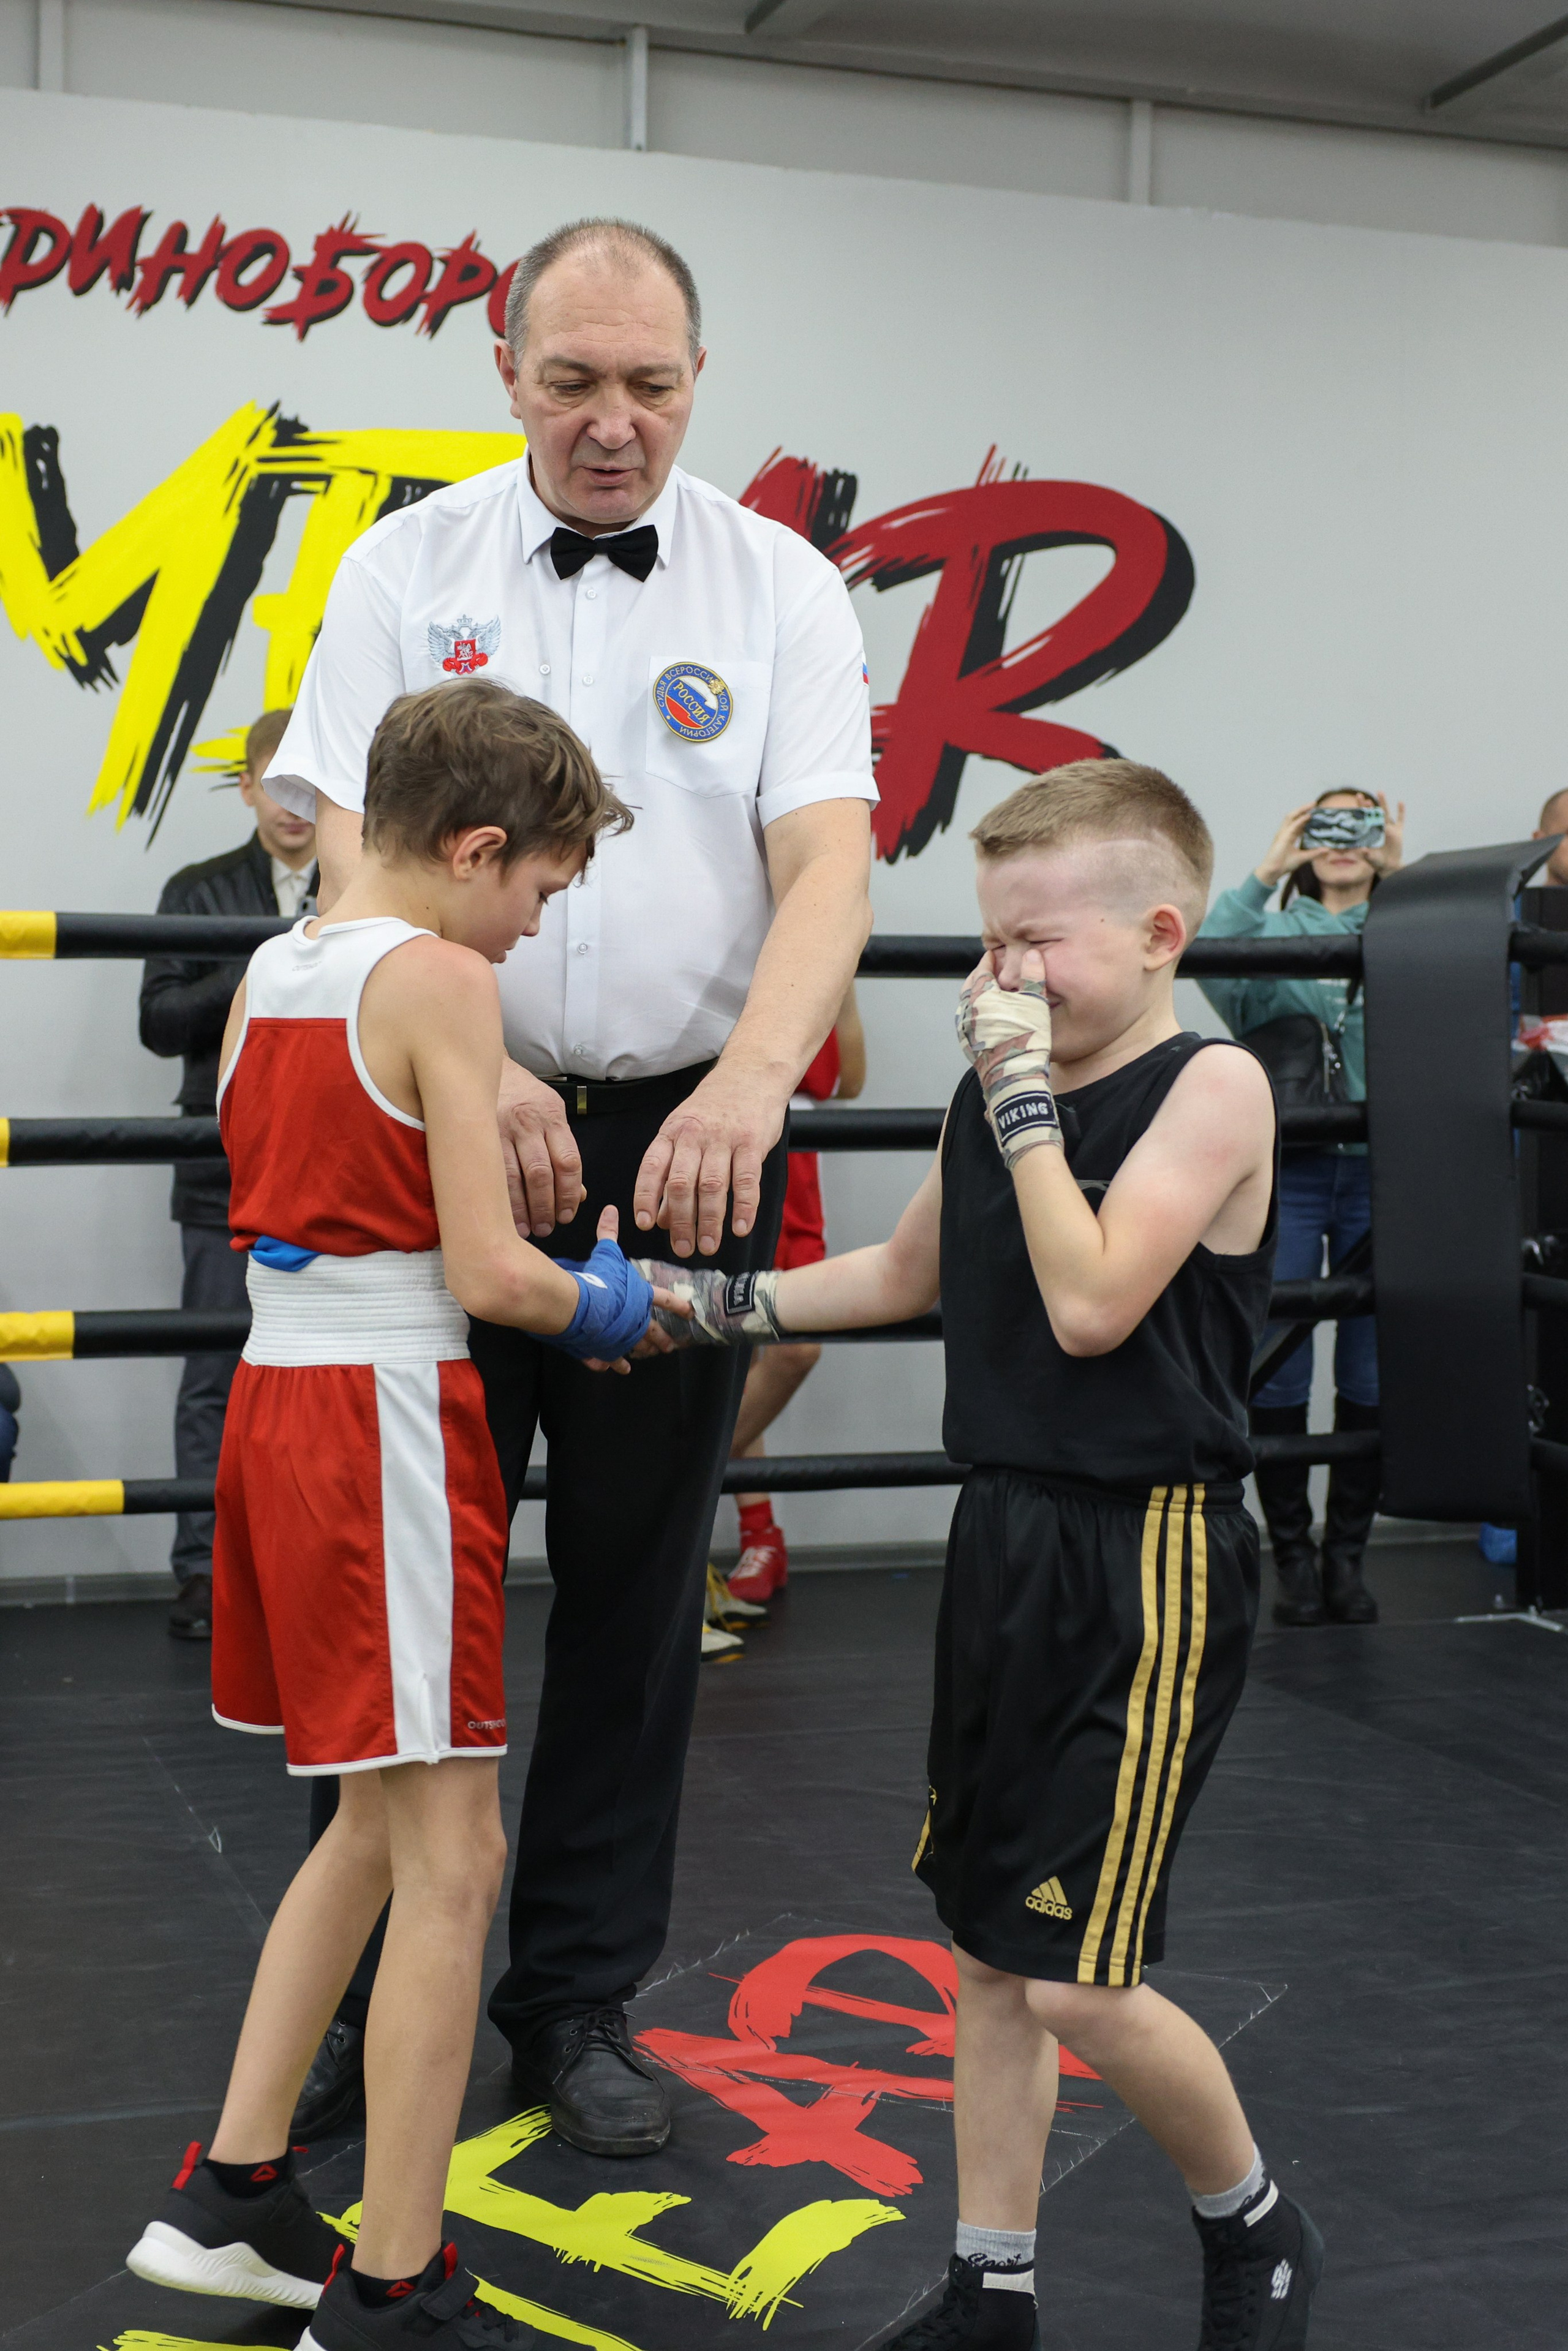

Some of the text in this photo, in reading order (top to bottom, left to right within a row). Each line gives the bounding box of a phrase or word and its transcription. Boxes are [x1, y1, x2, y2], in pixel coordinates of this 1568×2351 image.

[657, 666, 729, 738] СУДЬЯ ВСЕРОССИКОЙ КАТЕГОРИИ
[673, 681, 710, 724] РОССИЯ
[998, 1102, 1049, 1129] VIKING
[1025, 1896, 1073, 1920] adidas
